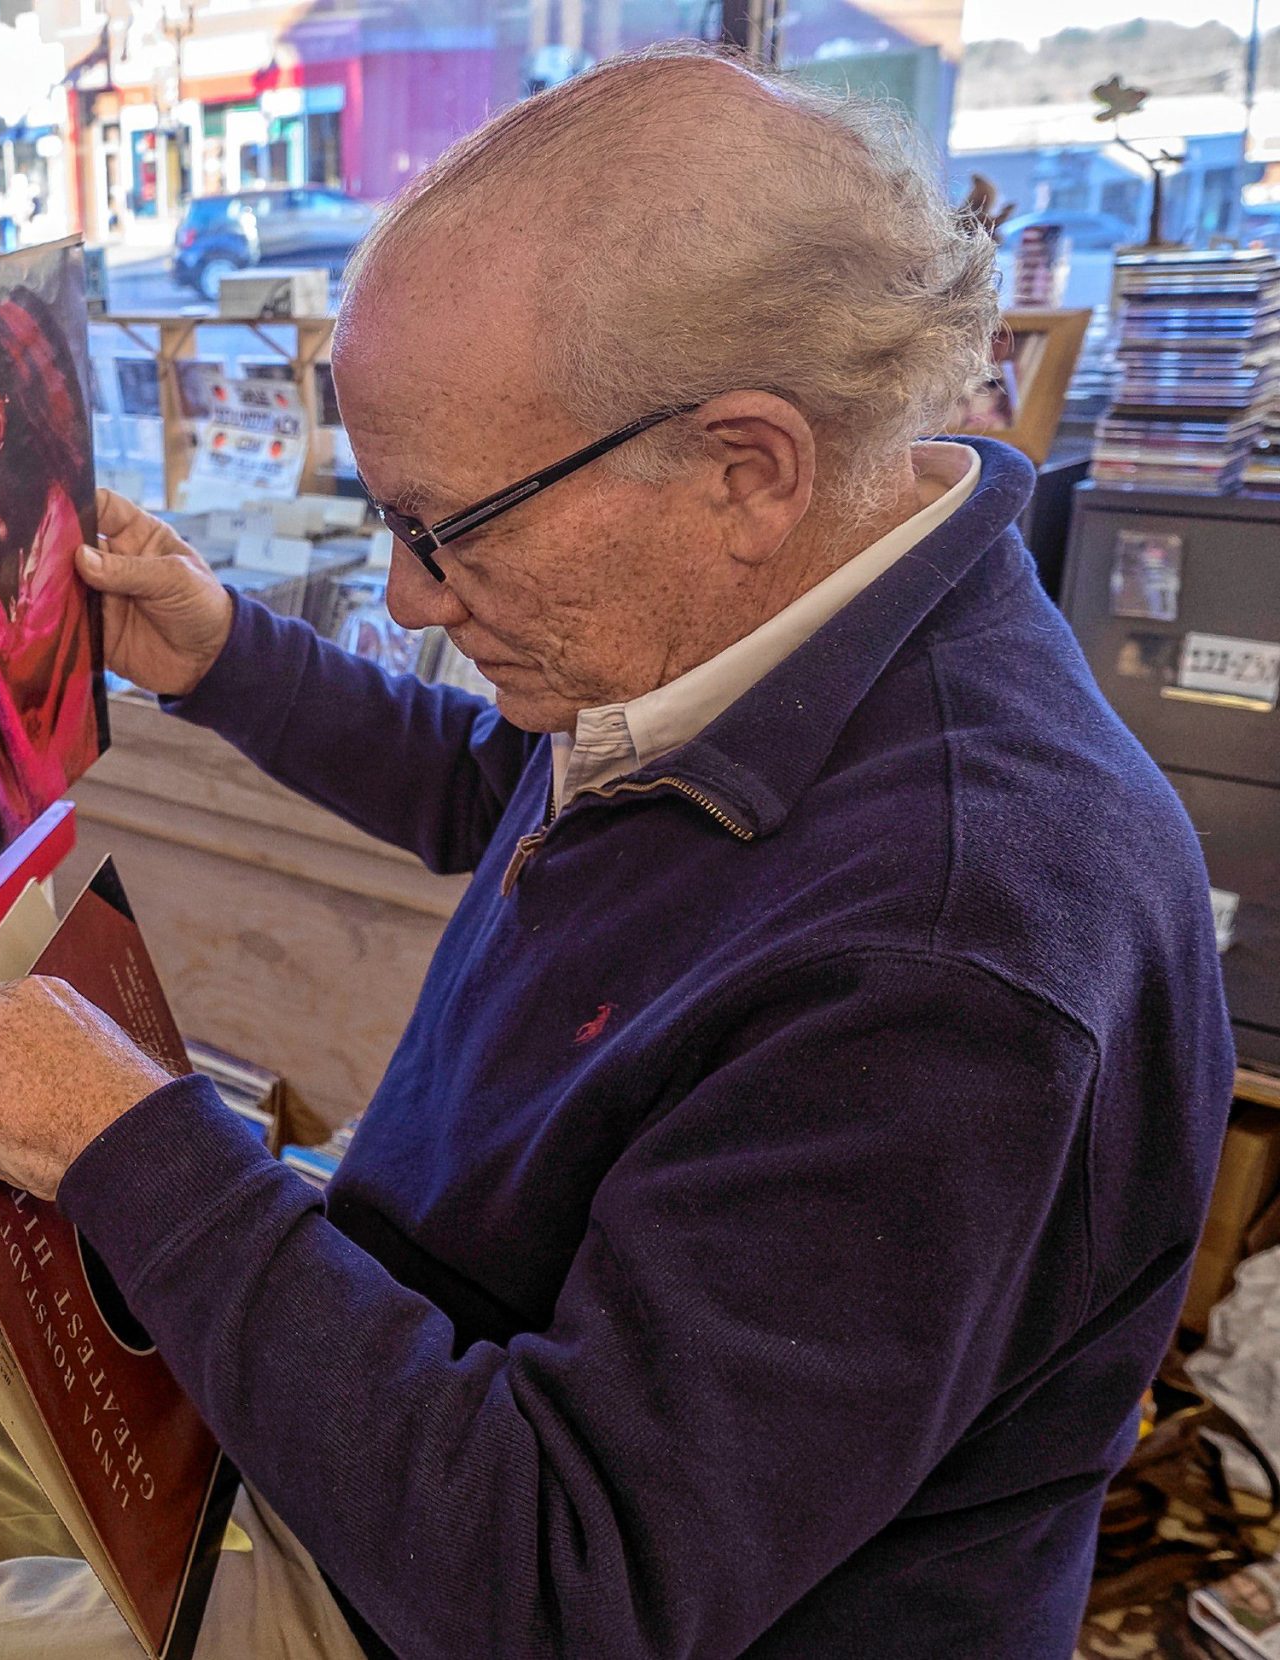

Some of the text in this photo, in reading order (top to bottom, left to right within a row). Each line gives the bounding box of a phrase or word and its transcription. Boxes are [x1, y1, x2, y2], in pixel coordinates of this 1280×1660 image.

[0, 1223, 131, 1510] LINDA RONSTADT
[10, 1189, 156, 1501] GREATEST HIT
